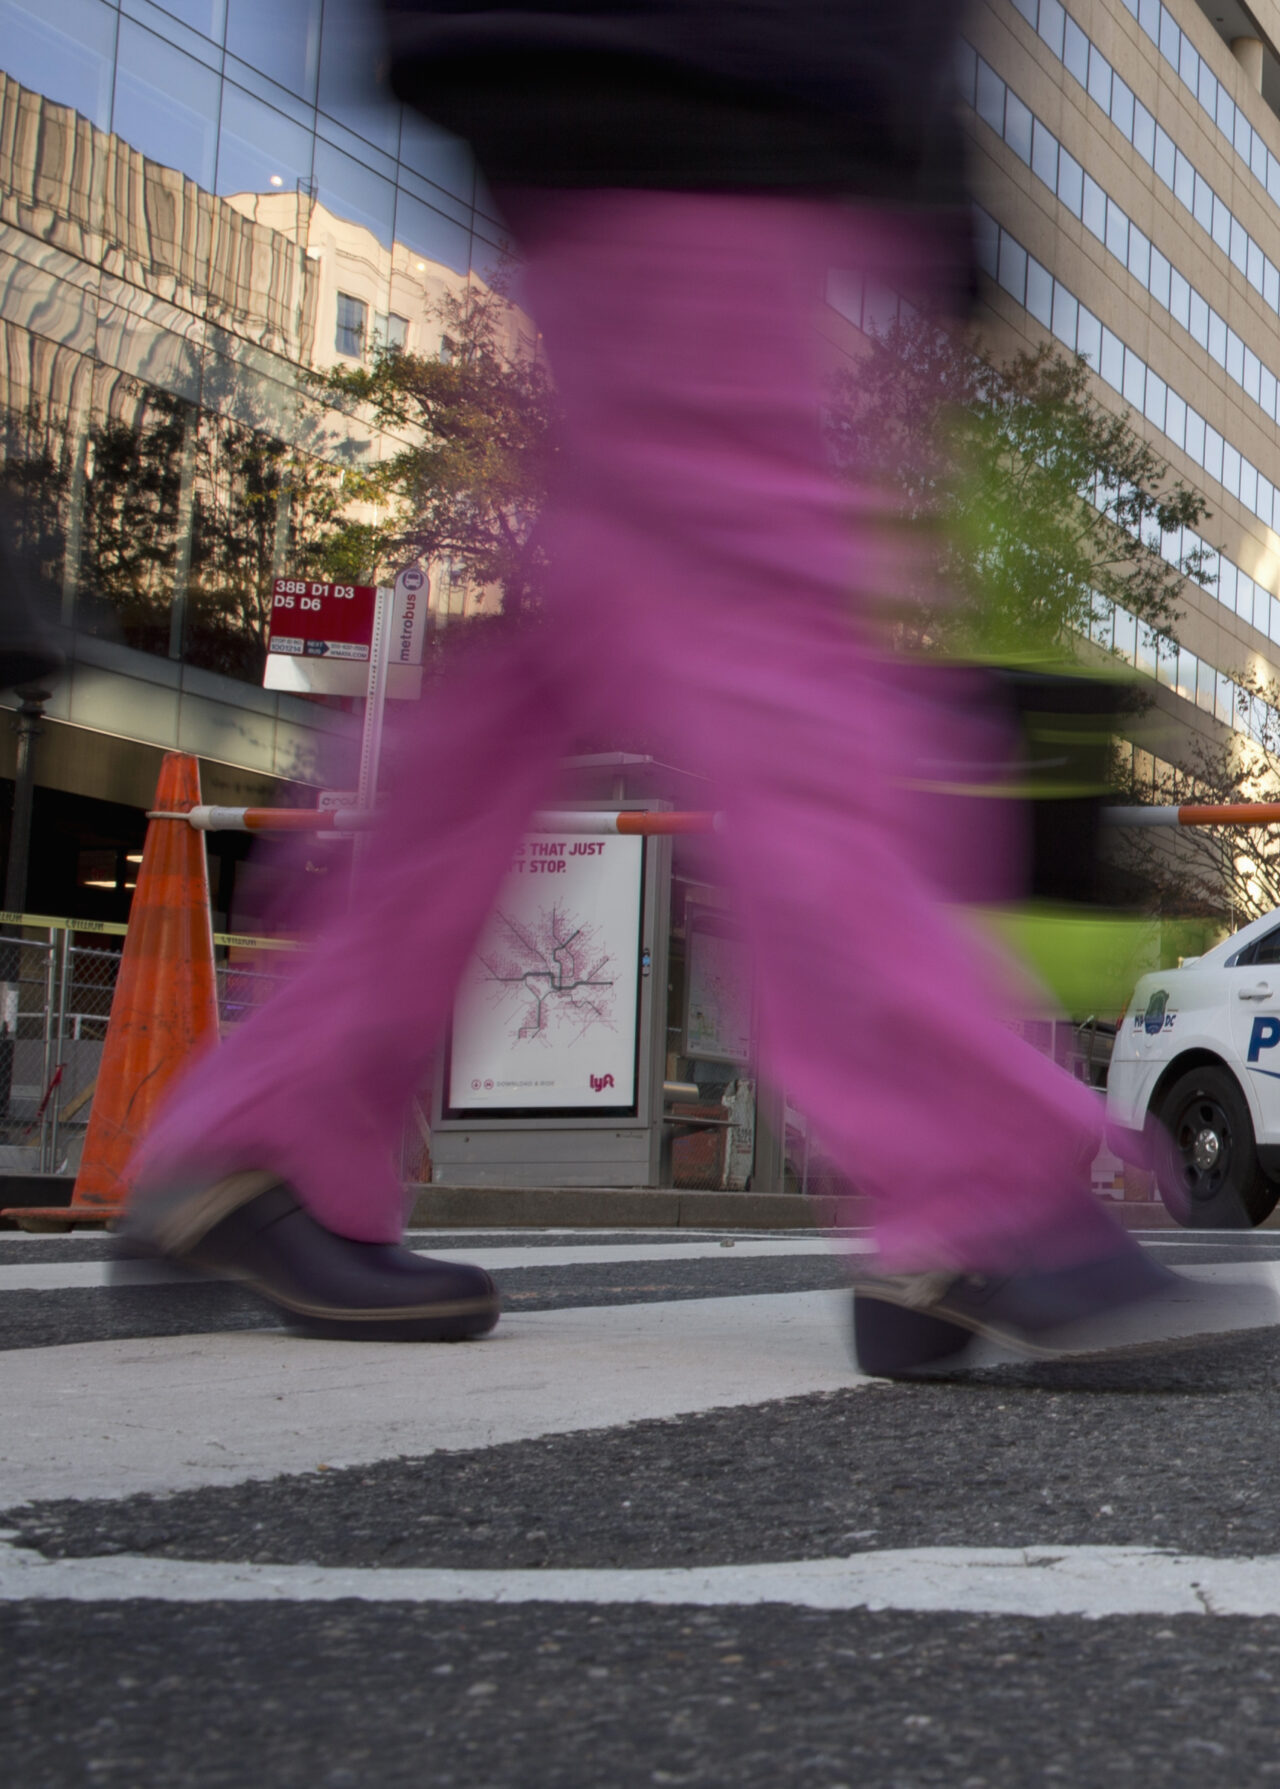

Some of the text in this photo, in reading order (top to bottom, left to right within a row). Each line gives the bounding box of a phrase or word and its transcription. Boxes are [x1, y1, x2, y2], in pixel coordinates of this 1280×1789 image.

[276, 580, 354, 599] 38B D1 D3
[274, 595, 321, 611] D5 D6
[400, 593, 416, 661] metrobus
[530, 843, 566, 856] THAT
[568, 842, 605, 856] JUST
[530, 860, 566, 873] STOP.
